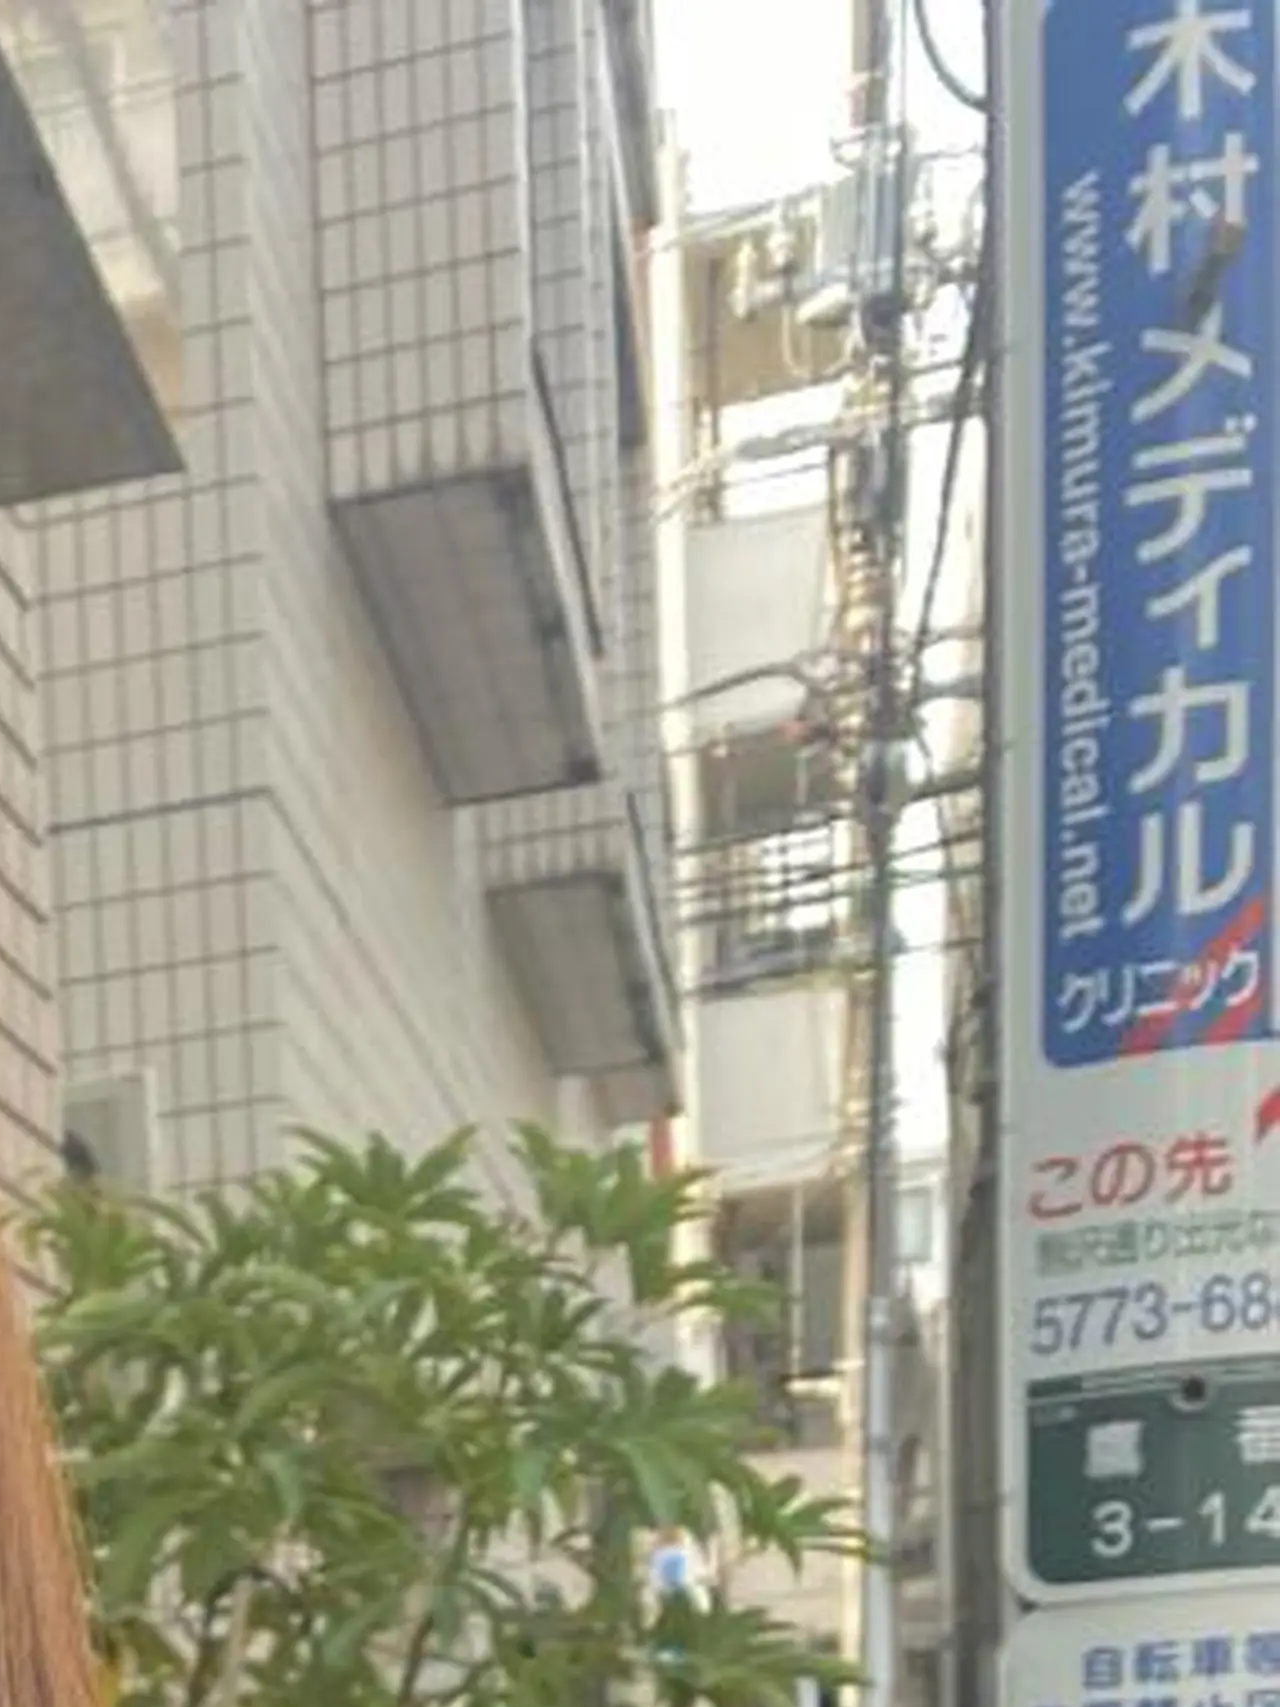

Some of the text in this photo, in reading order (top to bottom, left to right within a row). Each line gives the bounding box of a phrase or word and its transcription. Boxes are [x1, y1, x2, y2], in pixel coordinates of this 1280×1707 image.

[1123, 0, 1258, 925] 木村メディカル
[1057, 168, 1113, 938] www.kimura-medical.net
[1057, 945, 1258, 1034] クリニック
[1028, 1132, 1233, 1219] この先
[1030, 1271, 1280, 1357] 5773-68
